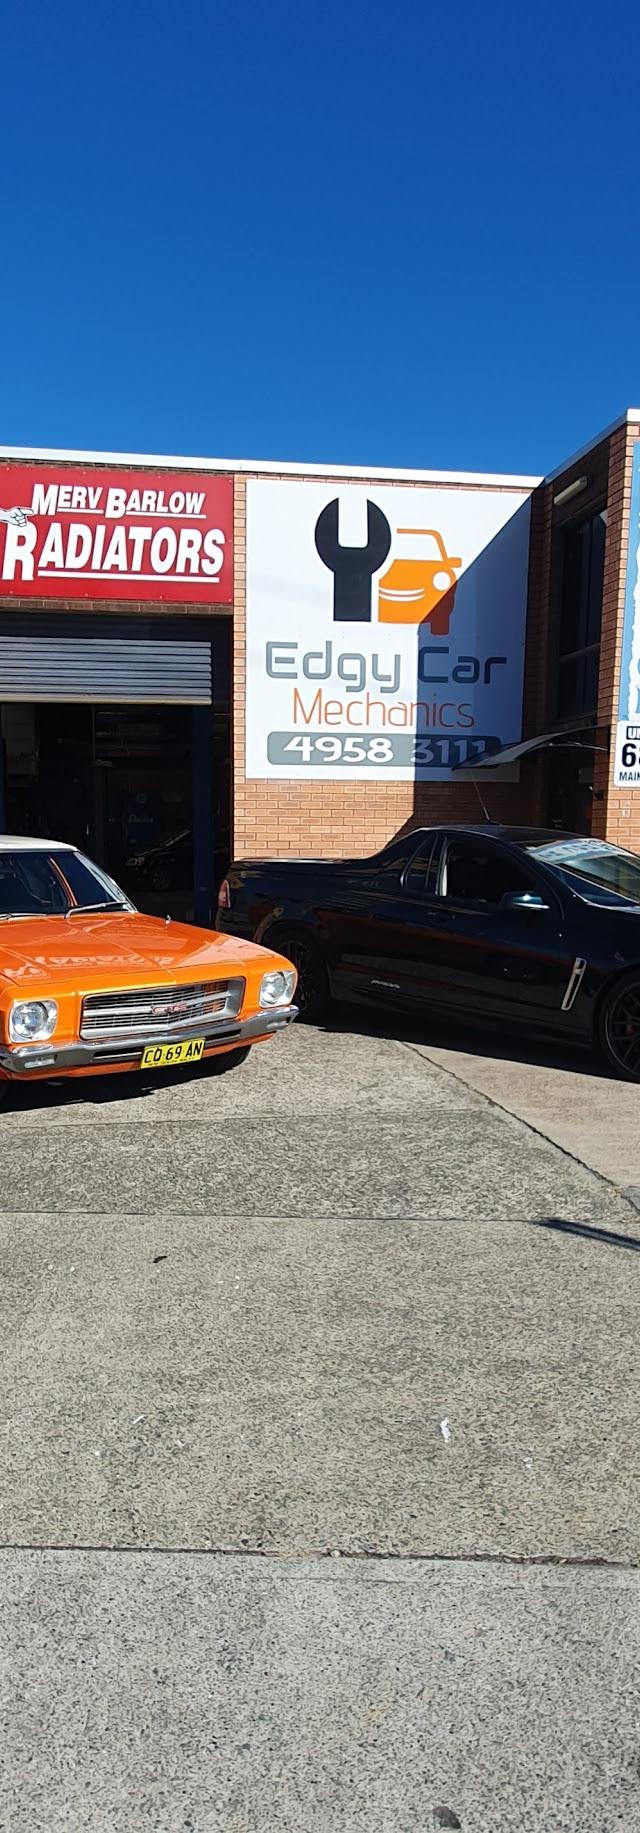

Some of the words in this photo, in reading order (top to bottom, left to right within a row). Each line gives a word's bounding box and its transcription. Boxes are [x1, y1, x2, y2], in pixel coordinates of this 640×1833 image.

[33, 484, 103, 515] MERV
[105, 487, 206, 519] BARLOW
[2, 520, 226, 580] RADIATORS
[265, 640, 401, 693] Edgy
[418, 646, 507, 684] Car
[292, 687, 475, 728] Mechanics
[283, 736, 394, 763] 4958
